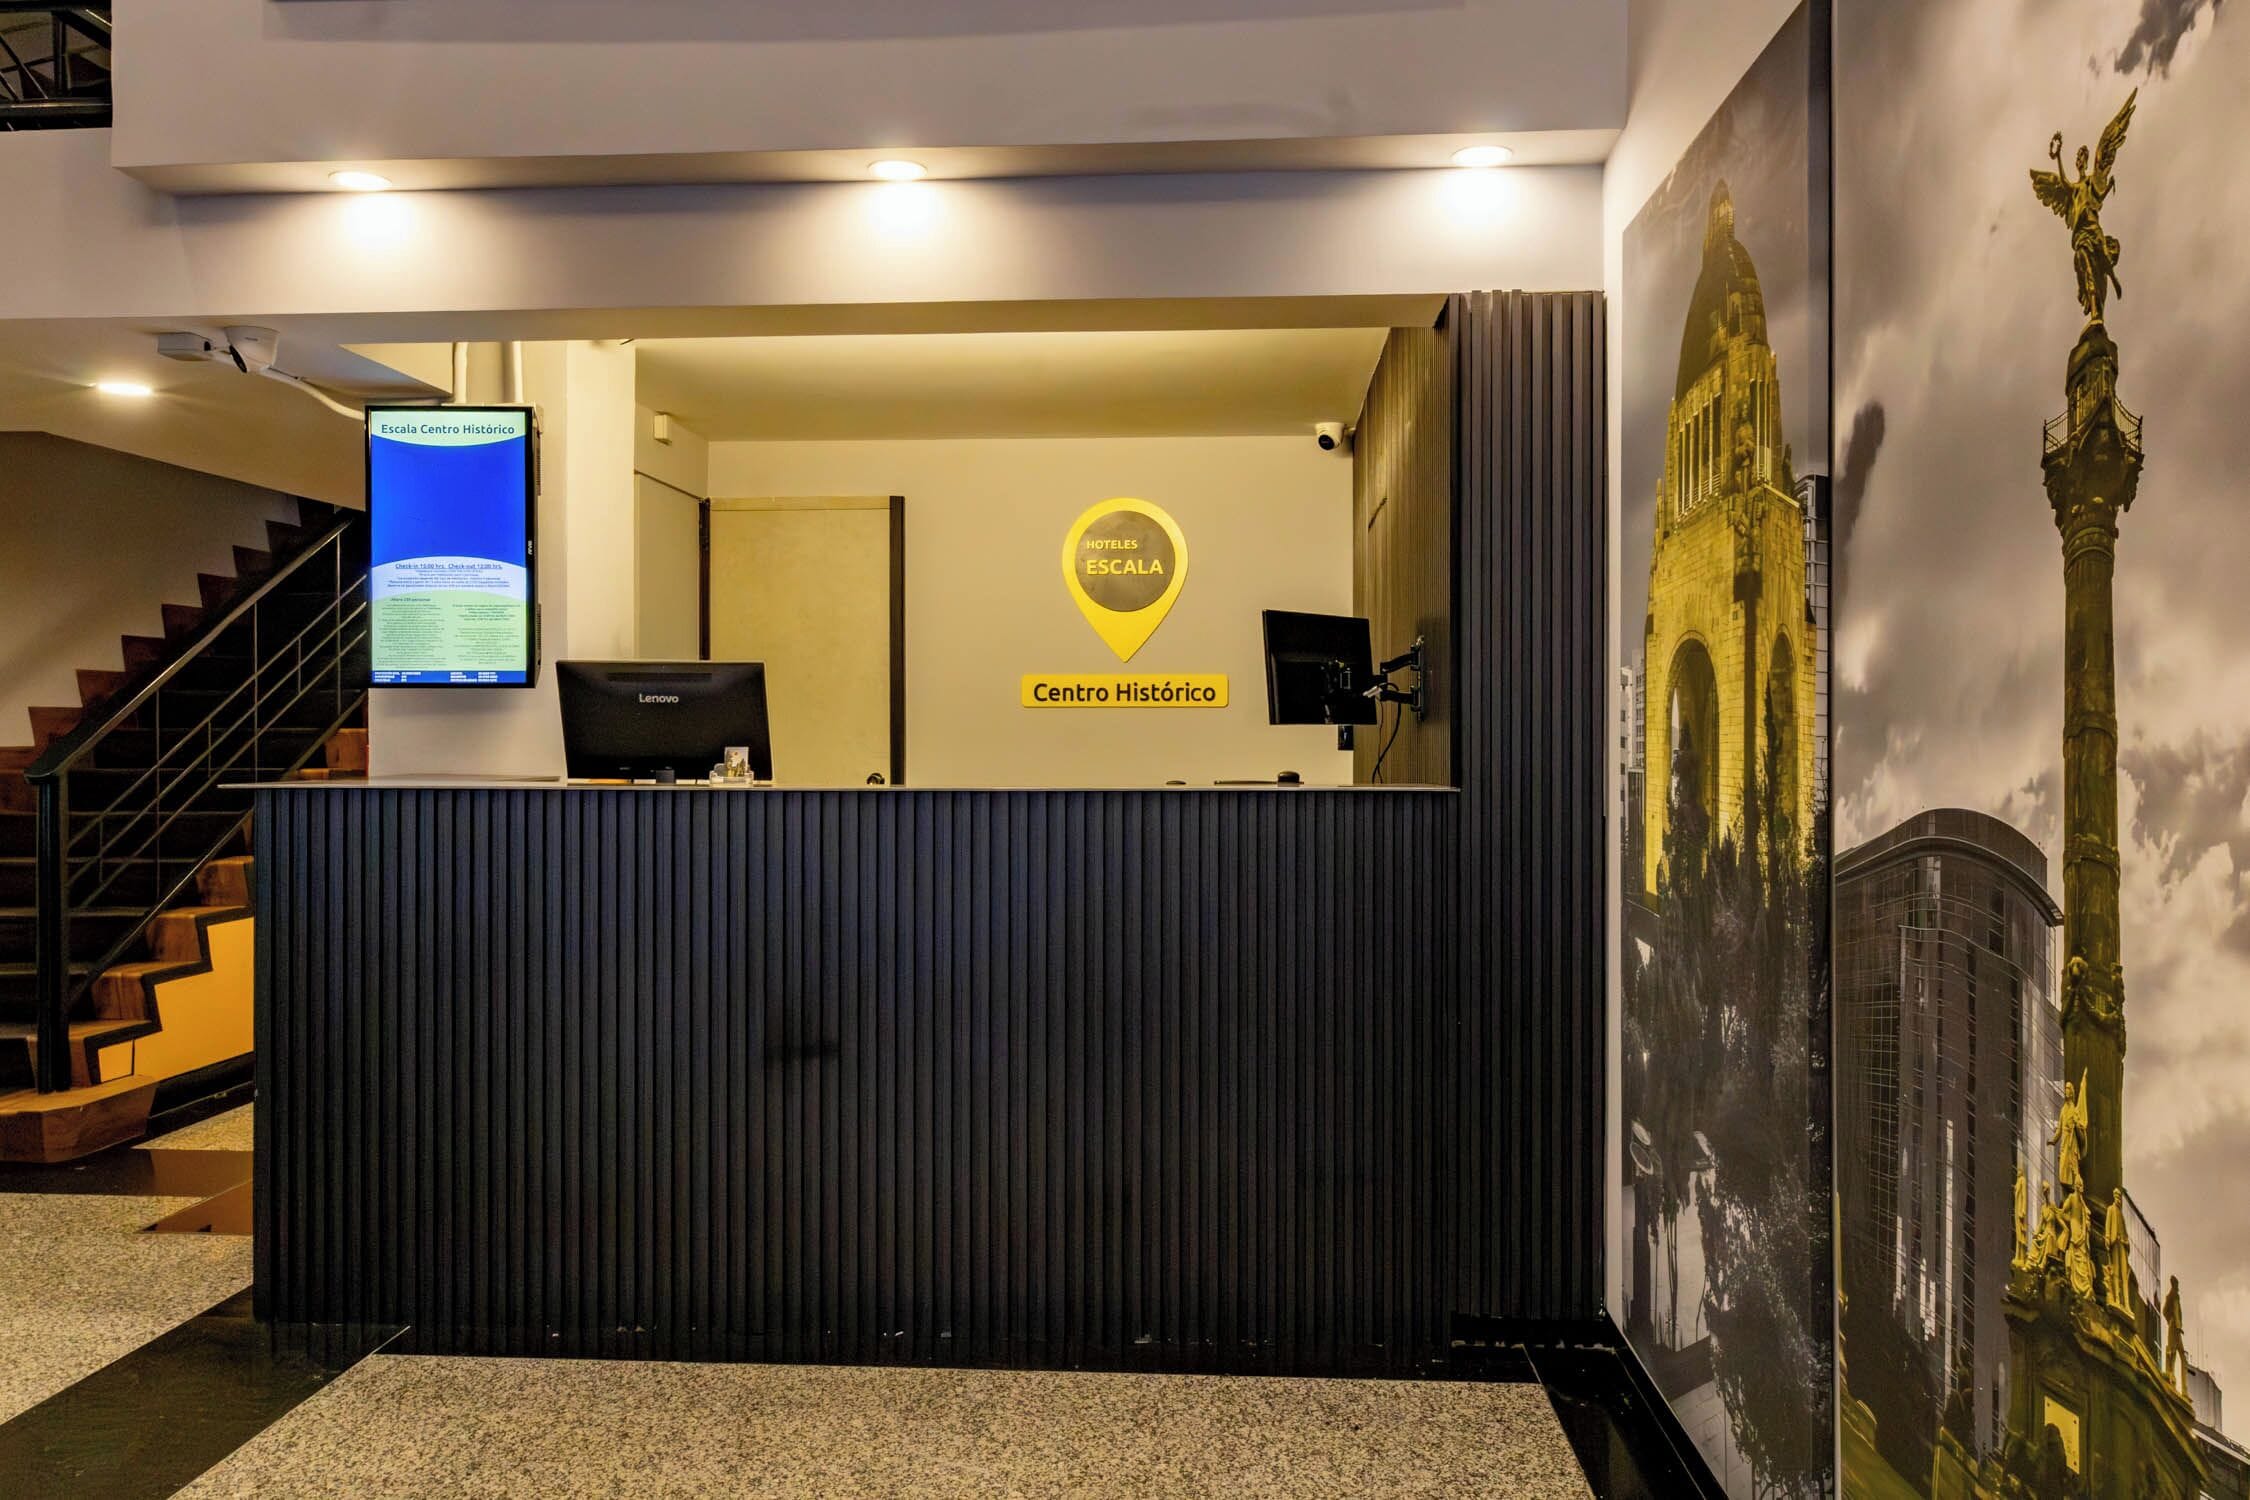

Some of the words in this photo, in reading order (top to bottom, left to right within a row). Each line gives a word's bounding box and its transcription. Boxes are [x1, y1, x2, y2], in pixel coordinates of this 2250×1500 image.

[381, 424, 417, 434] Escala
[420, 424, 460, 434] Centro
[463, 423, 515, 435] Histórico
[1086, 540, 1138, 550] HOTELES
[1086, 558, 1164, 576] ESCALA
[1033, 683, 1109, 703] Centro
[1115, 681, 1217, 703] Histórico
[638, 693, 679, 704] Lenovo
